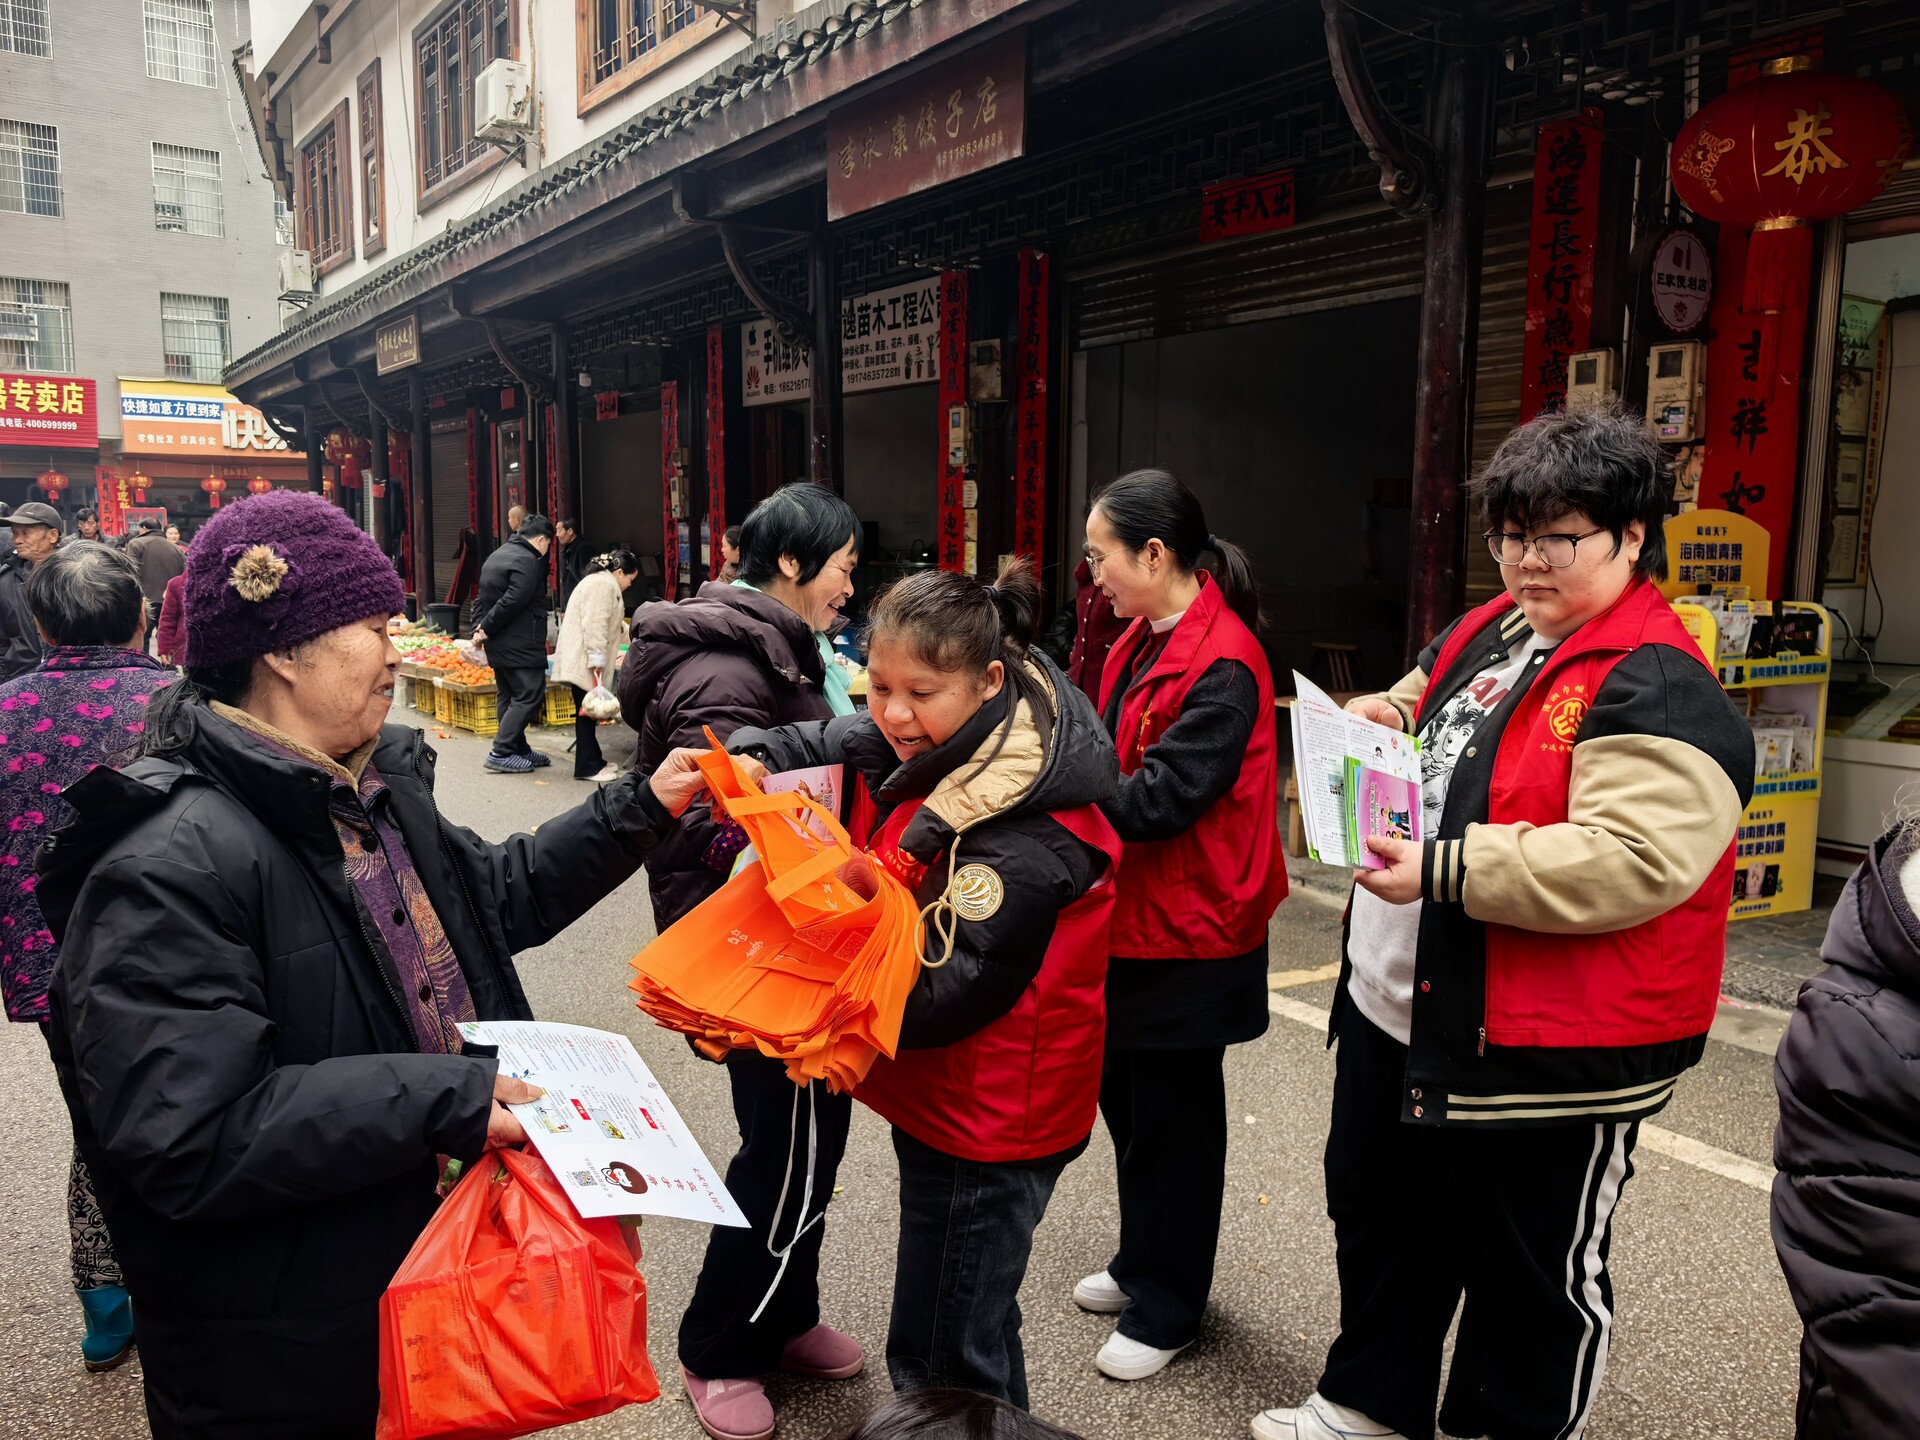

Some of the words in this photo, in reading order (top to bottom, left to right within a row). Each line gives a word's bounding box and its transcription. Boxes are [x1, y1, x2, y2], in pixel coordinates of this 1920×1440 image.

[1761, 100, 1849, 184] 恭
[123, 398, 221, 418] 快捷如意方便到家
